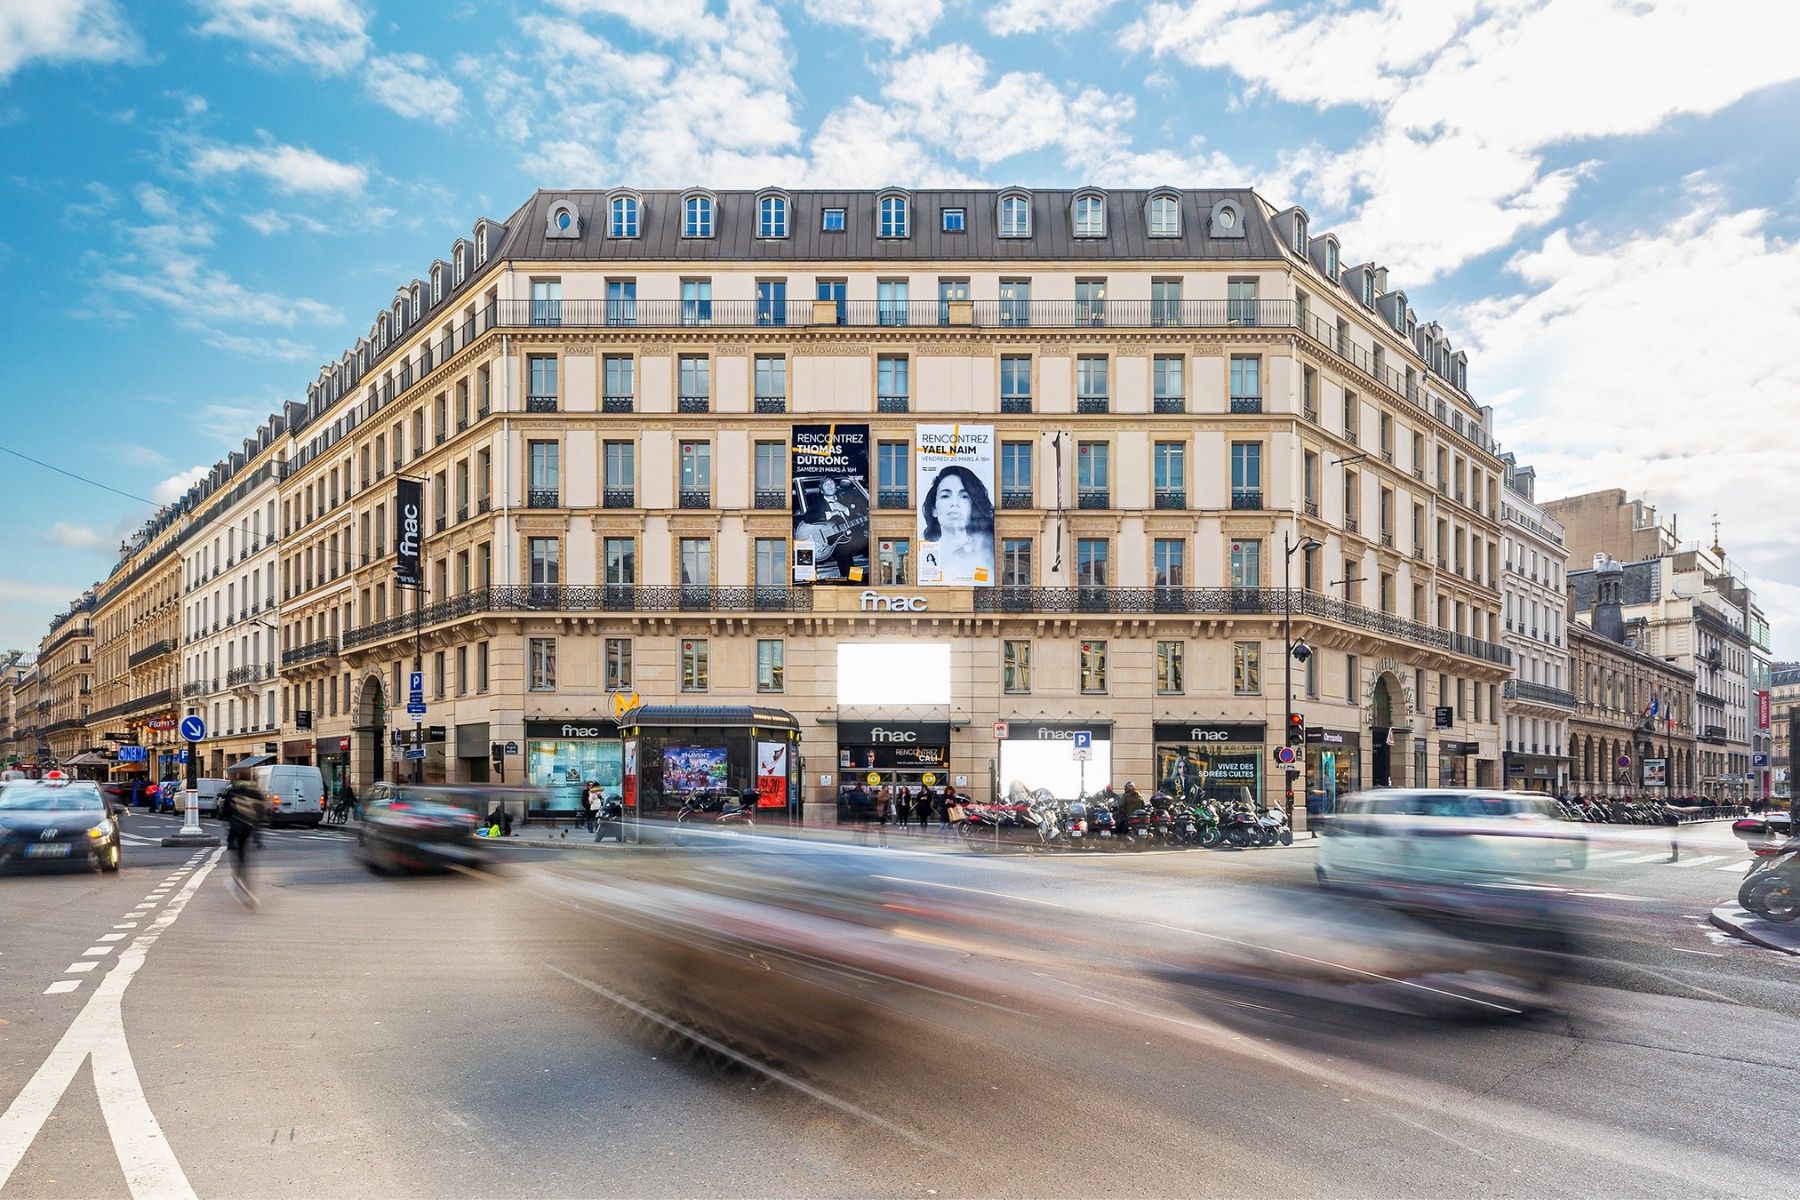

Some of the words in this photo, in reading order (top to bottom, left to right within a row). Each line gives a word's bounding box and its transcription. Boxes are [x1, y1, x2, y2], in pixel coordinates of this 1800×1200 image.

[797, 433, 864, 444] RENCONTREZ
[922, 434, 989, 444] RENCONTREZ
[797, 444, 843, 454] THOMAS
[922, 445, 947, 454] YAEL
[949, 445, 977, 455] NAIM
[797, 455, 849, 465] DUTRONC
[399, 503, 418, 557] fnac
[860, 590, 928, 612] fnac
[413, 676, 420, 688] P
[561, 724, 599, 737] fnac
[871, 727, 917, 742] fnac
[1037, 727, 1074, 740] fnac
[1191, 728, 1229, 741] fnac
[1078, 735, 1087, 746] P
[895, 748, 938, 756] RENCONTREZ
[918, 754, 938, 762] CALI
[1754, 755, 1762, 764] P
[1198, 769, 1228, 778] SOIRÉES
[1228, 770, 1254, 778] CULTES
